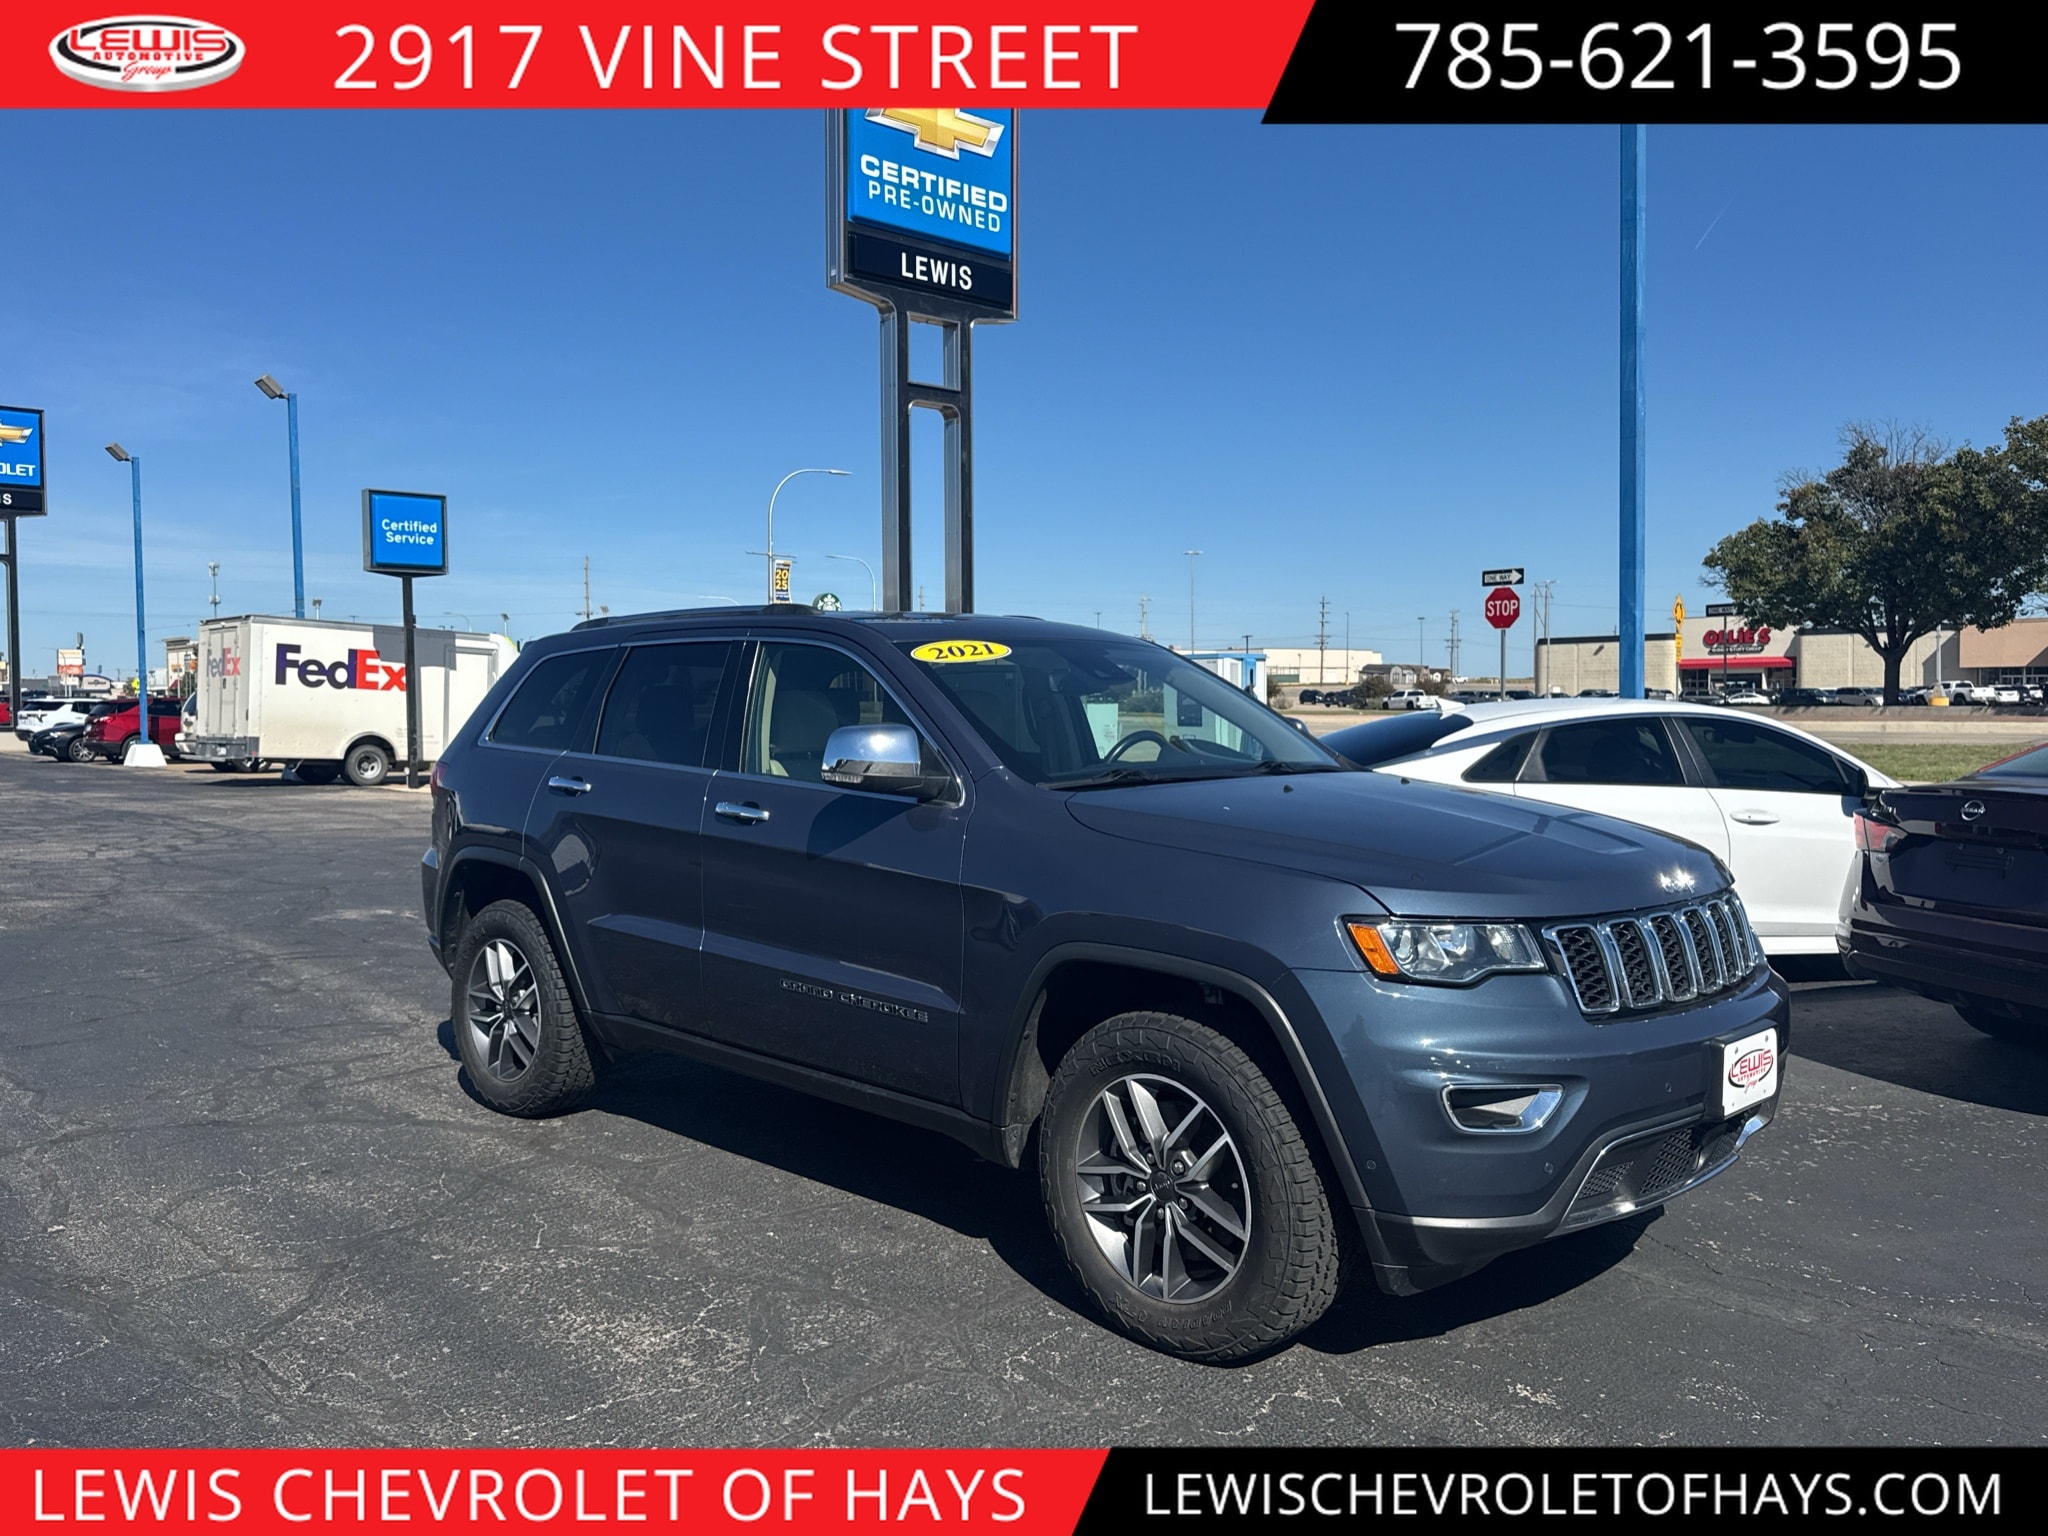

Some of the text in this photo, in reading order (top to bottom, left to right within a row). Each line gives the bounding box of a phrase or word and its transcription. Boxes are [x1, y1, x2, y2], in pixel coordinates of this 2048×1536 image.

[860, 154, 1008, 213] CERTIFIED
[868, 180, 1001, 233] PRE-OWNED
[901, 252, 973, 291] LEWIS
[381, 518, 438, 533] Certified
[385, 531, 435, 545] Service
[776, 569, 789, 580] 20
[776, 579, 788, 590] 25
[1486, 600, 1519, 617] STOP
[207, 647, 241, 678] FedEx
[928, 643, 995, 660] 2021
[275, 643, 406, 692] FedEx
[779, 978, 929, 1024] GRAND CHEROKEE
[1731, 1049, 1771, 1078] LEWIS
